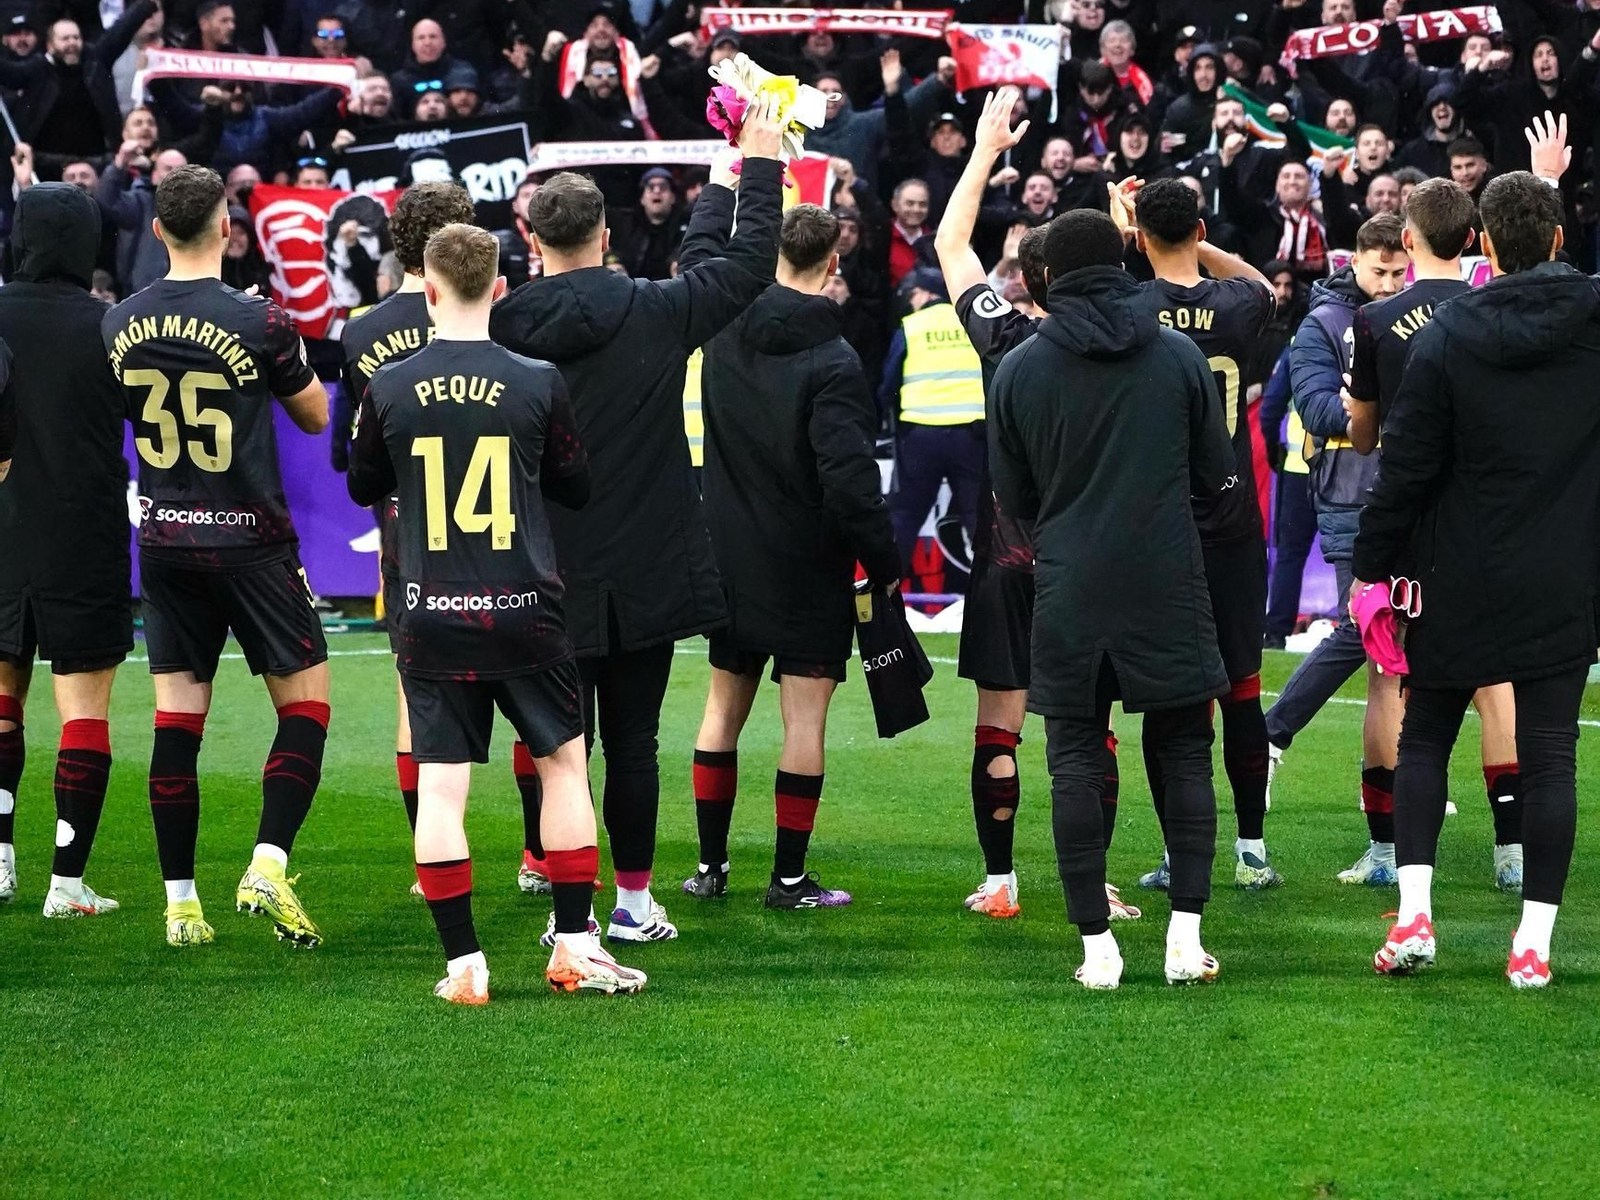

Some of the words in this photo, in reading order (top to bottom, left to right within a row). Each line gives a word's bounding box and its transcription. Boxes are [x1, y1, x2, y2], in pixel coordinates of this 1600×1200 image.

[1158, 307, 1215, 331] SOW
[161, 314, 259, 387] MARTÍNEZ
[357, 326, 421, 379] MANU
[414, 375, 506, 408] PEQUE
[122, 368, 232, 473] 35
[411, 436, 516, 552] 14
[155, 508, 256, 527] socios.com
[426, 590, 538, 612] socios.com
